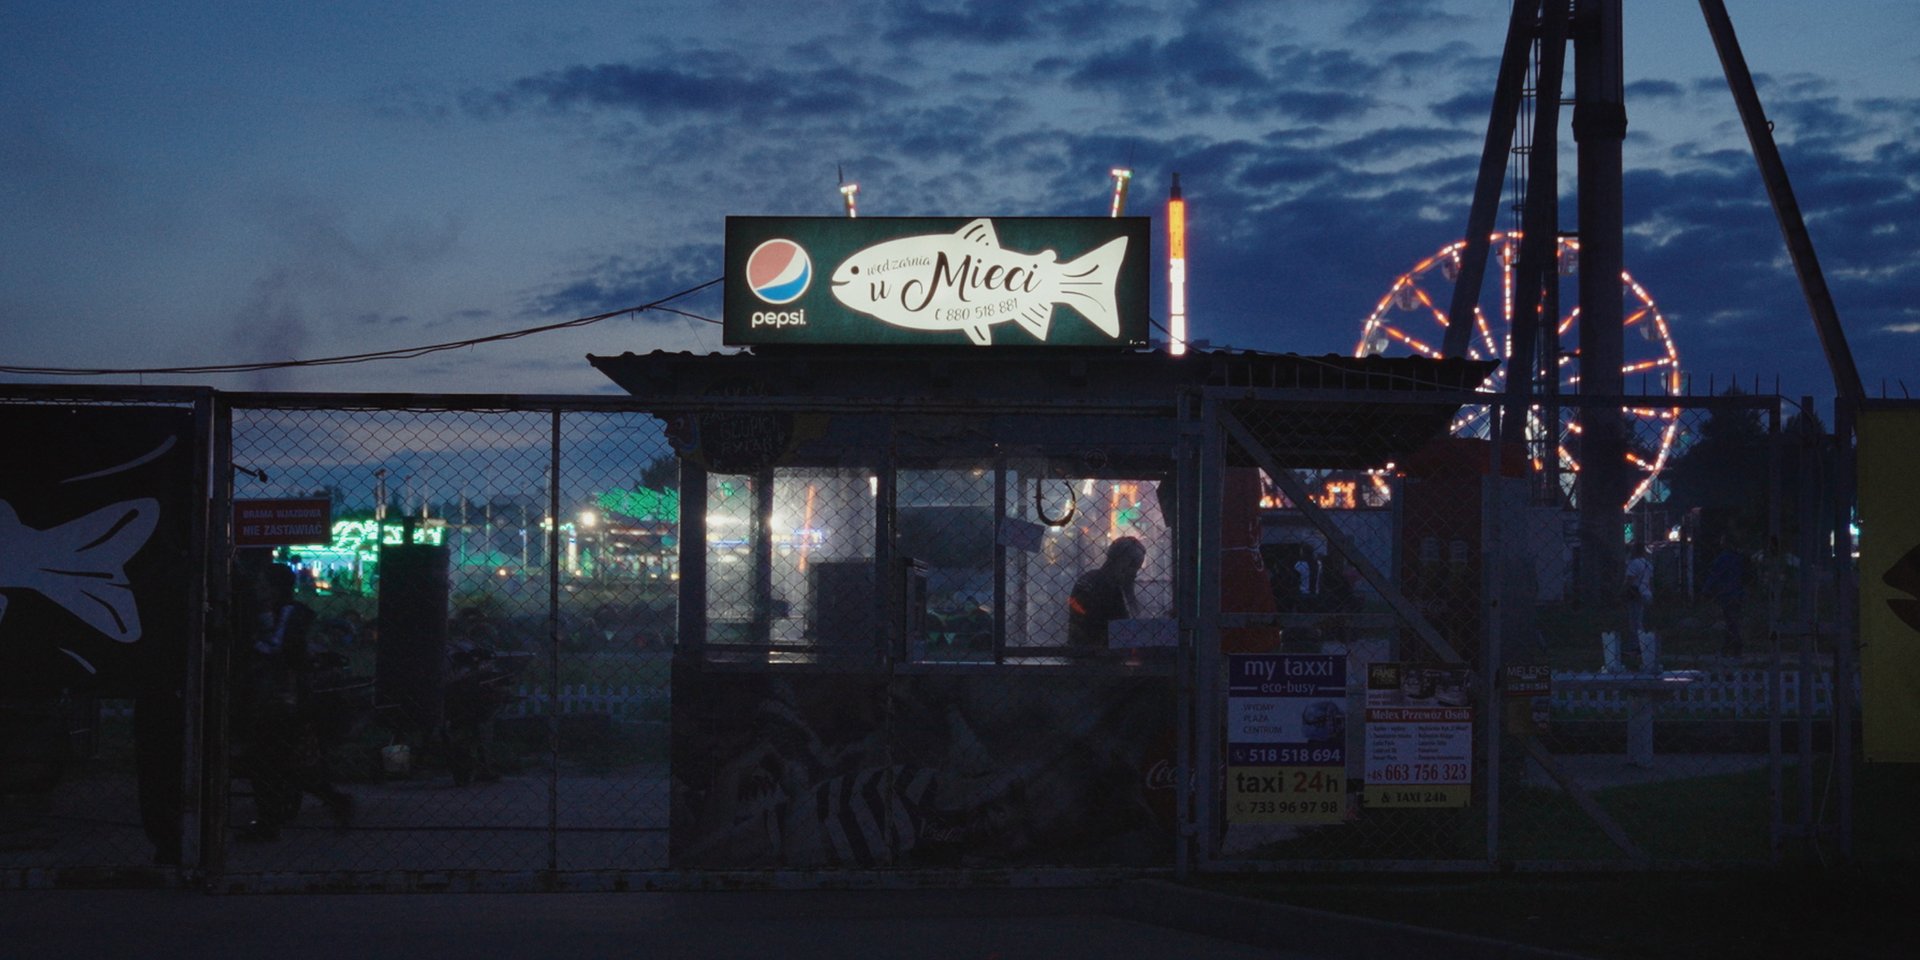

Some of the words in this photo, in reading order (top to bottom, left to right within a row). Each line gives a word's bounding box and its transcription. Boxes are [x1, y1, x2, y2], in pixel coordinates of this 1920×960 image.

[901, 251, 1042, 313] Mieci
[946, 308, 970, 321] 880
[975, 304, 995, 319] 518
[1000, 298, 1018, 314] 881
[751, 308, 804, 329] pepsi
[242, 509, 273, 519] BRAMA
[242, 525, 260, 536] NIE
[263, 521, 322, 536] ZASTAWIAĆ
[1244, 659, 1276, 680] my
[1284, 656, 1334, 676] taxxi
[1261, 681, 1316, 694] eco-busy
[1249, 748, 1277, 762] 518
[1281, 748, 1308, 762] 518
[1312, 748, 1341, 762] 694
[1385, 764, 1409, 781] 663
[1414, 764, 1439, 781] 756
[1442, 764, 1467, 781] 323
[1236, 771, 1284, 793] taxi
[1381, 792, 1391, 803] &
[1396, 792, 1421, 803] TAXI
[1250, 801, 1276, 813] 733
[1279, 801, 1297, 813] 96
[1301, 801, 1317, 813] 97
[1320, 801, 1338, 813] 98
